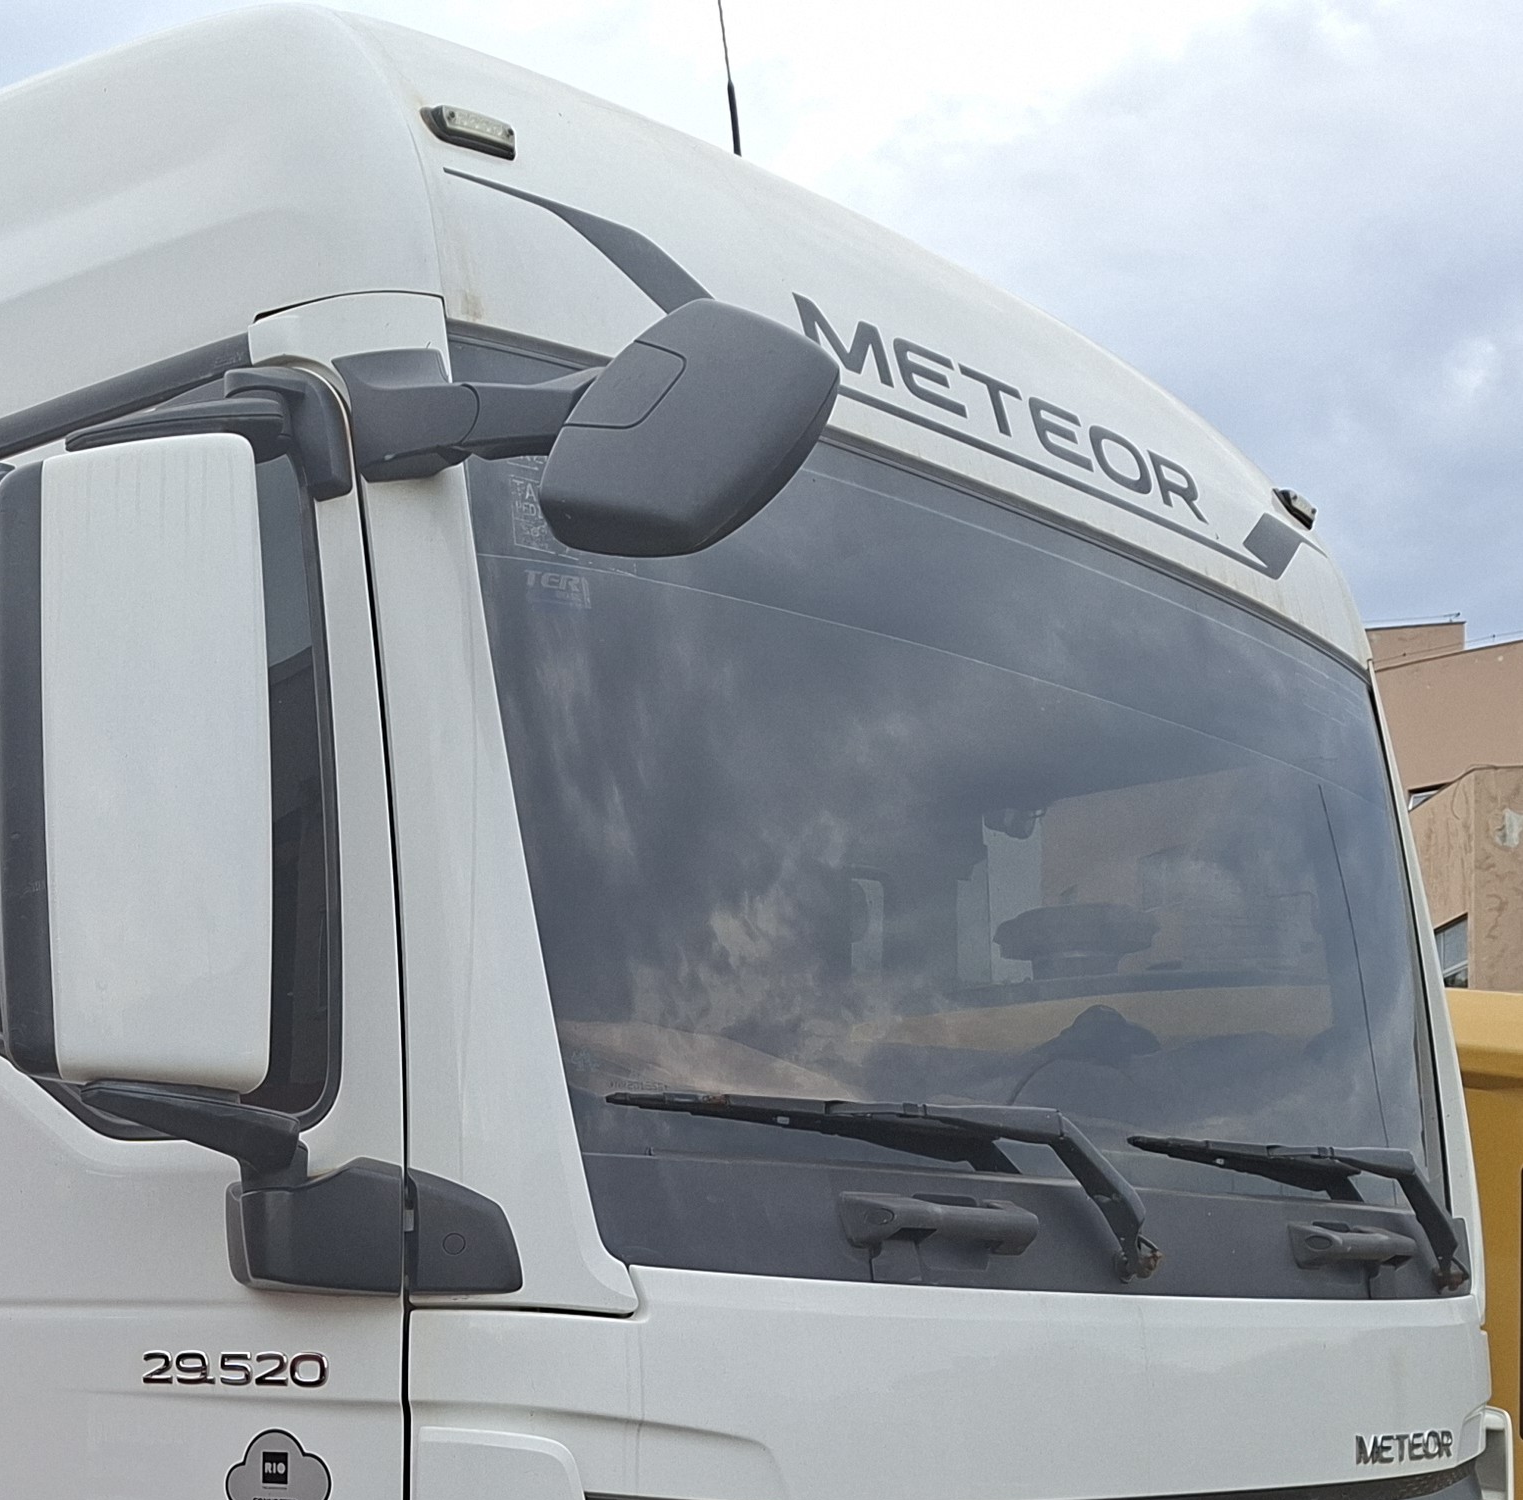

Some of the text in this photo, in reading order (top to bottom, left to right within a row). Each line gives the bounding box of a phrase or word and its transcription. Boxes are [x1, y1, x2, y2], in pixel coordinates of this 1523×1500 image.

[792, 293, 1209, 523] METEOR
[142, 1350, 329, 1388] 29.520
[1355, 1431, 1453, 1465] METEOR
[264, 1462, 286, 1474] RIO
